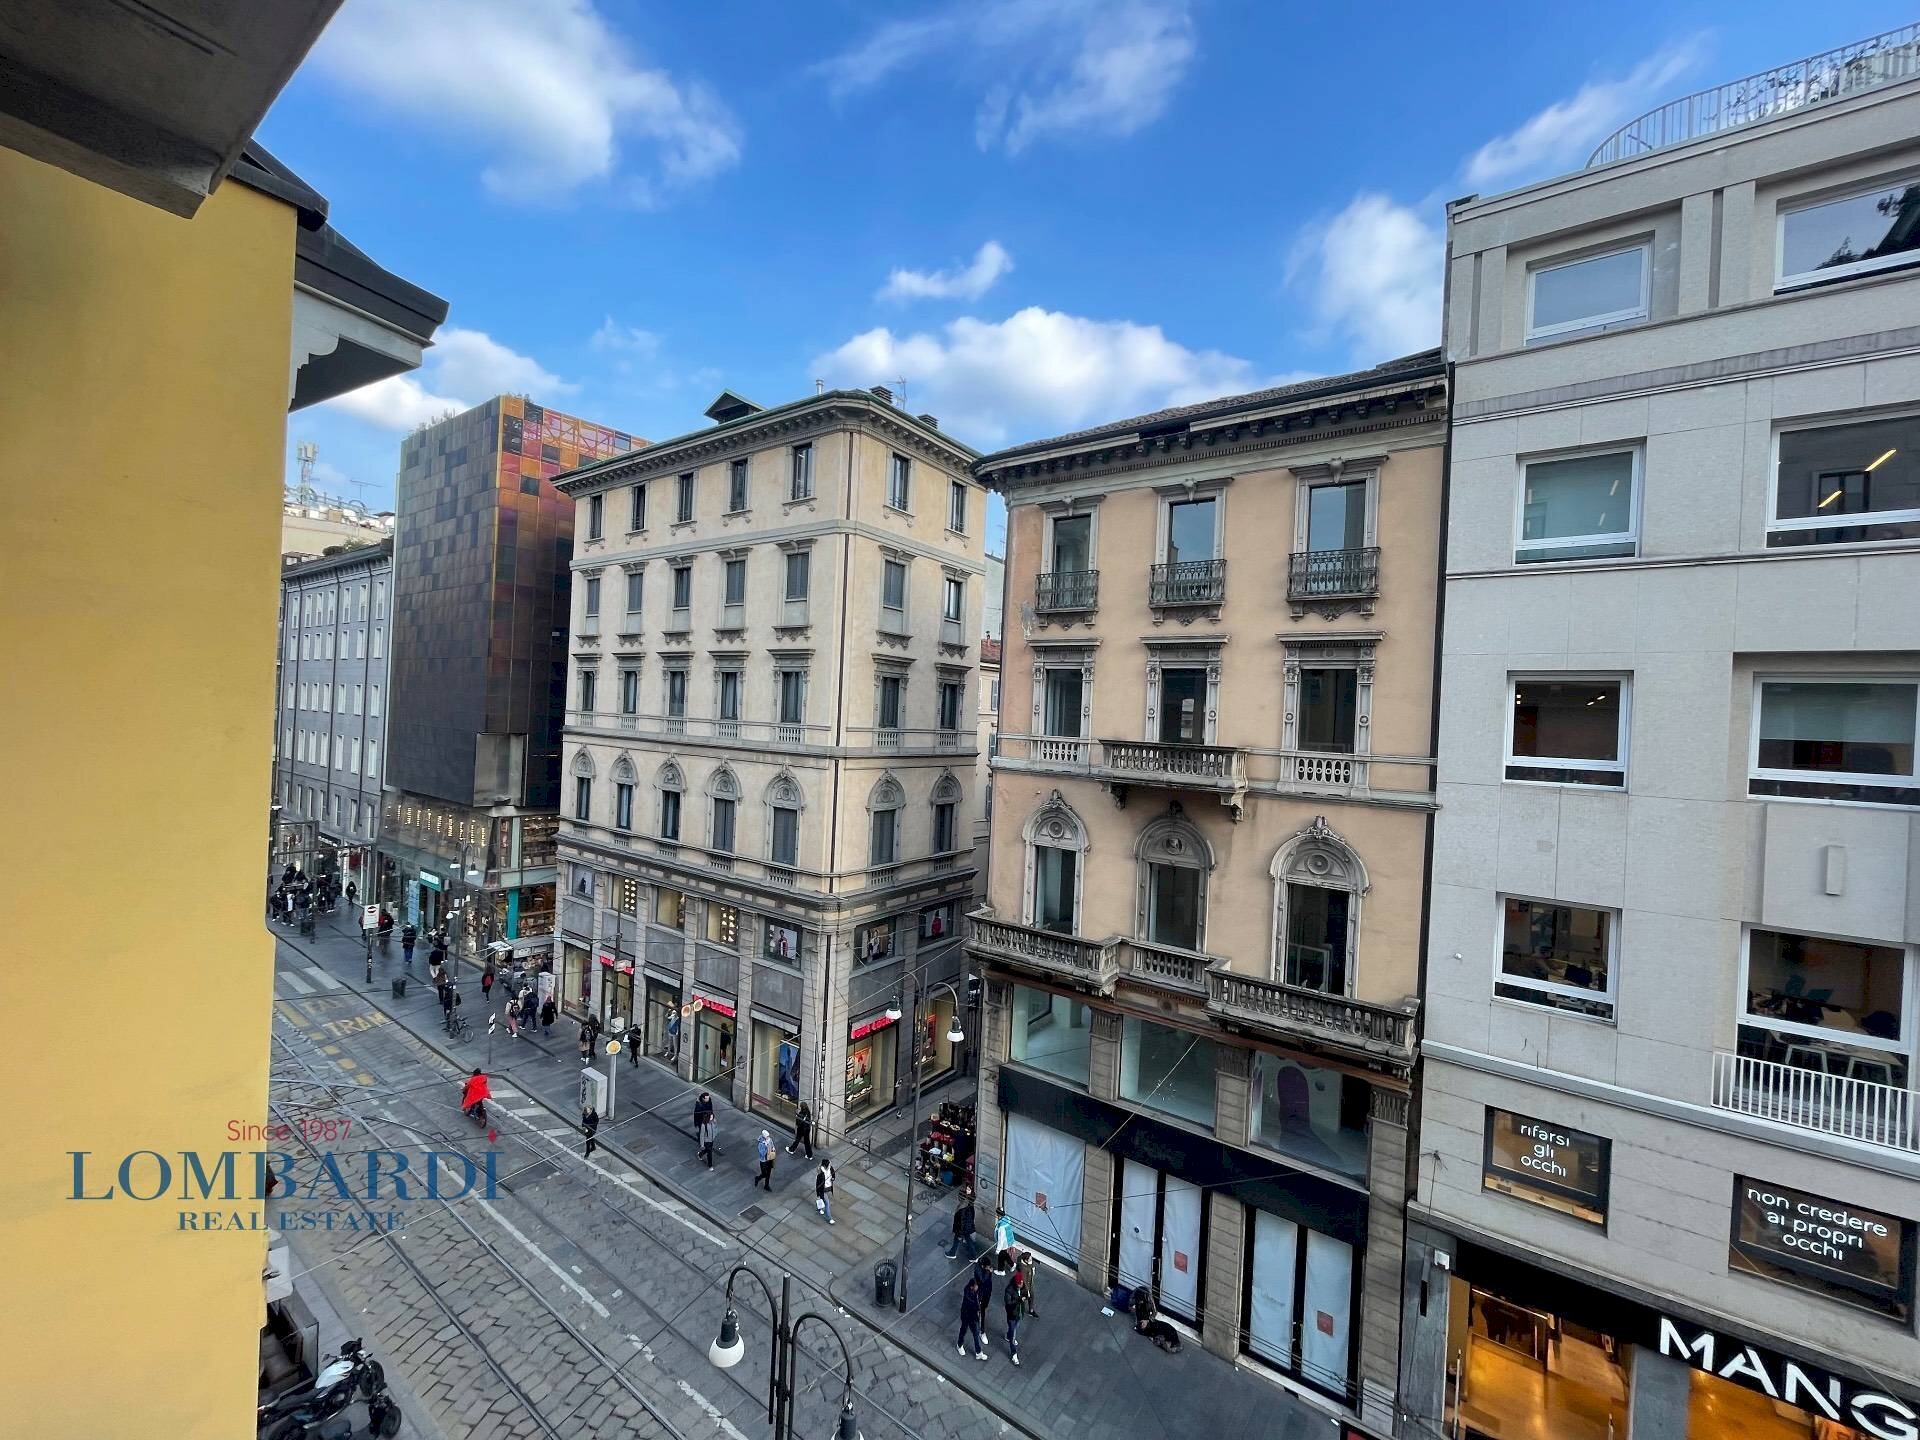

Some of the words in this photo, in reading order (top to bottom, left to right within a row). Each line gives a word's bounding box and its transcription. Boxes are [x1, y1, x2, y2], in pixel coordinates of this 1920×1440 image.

[1520, 1124, 1570, 1147] rifarsi
[1533, 1143, 1554, 1158] gli
[1520, 1155, 1566, 1177] occhi
[1747, 1188, 1790, 1209] non
[1797, 1203, 1888, 1237] credere
[1767, 1212, 1785, 1226] ai
[1793, 1219, 1863, 1249] propri
[1783, 1233, 1844, 1261] occhi
